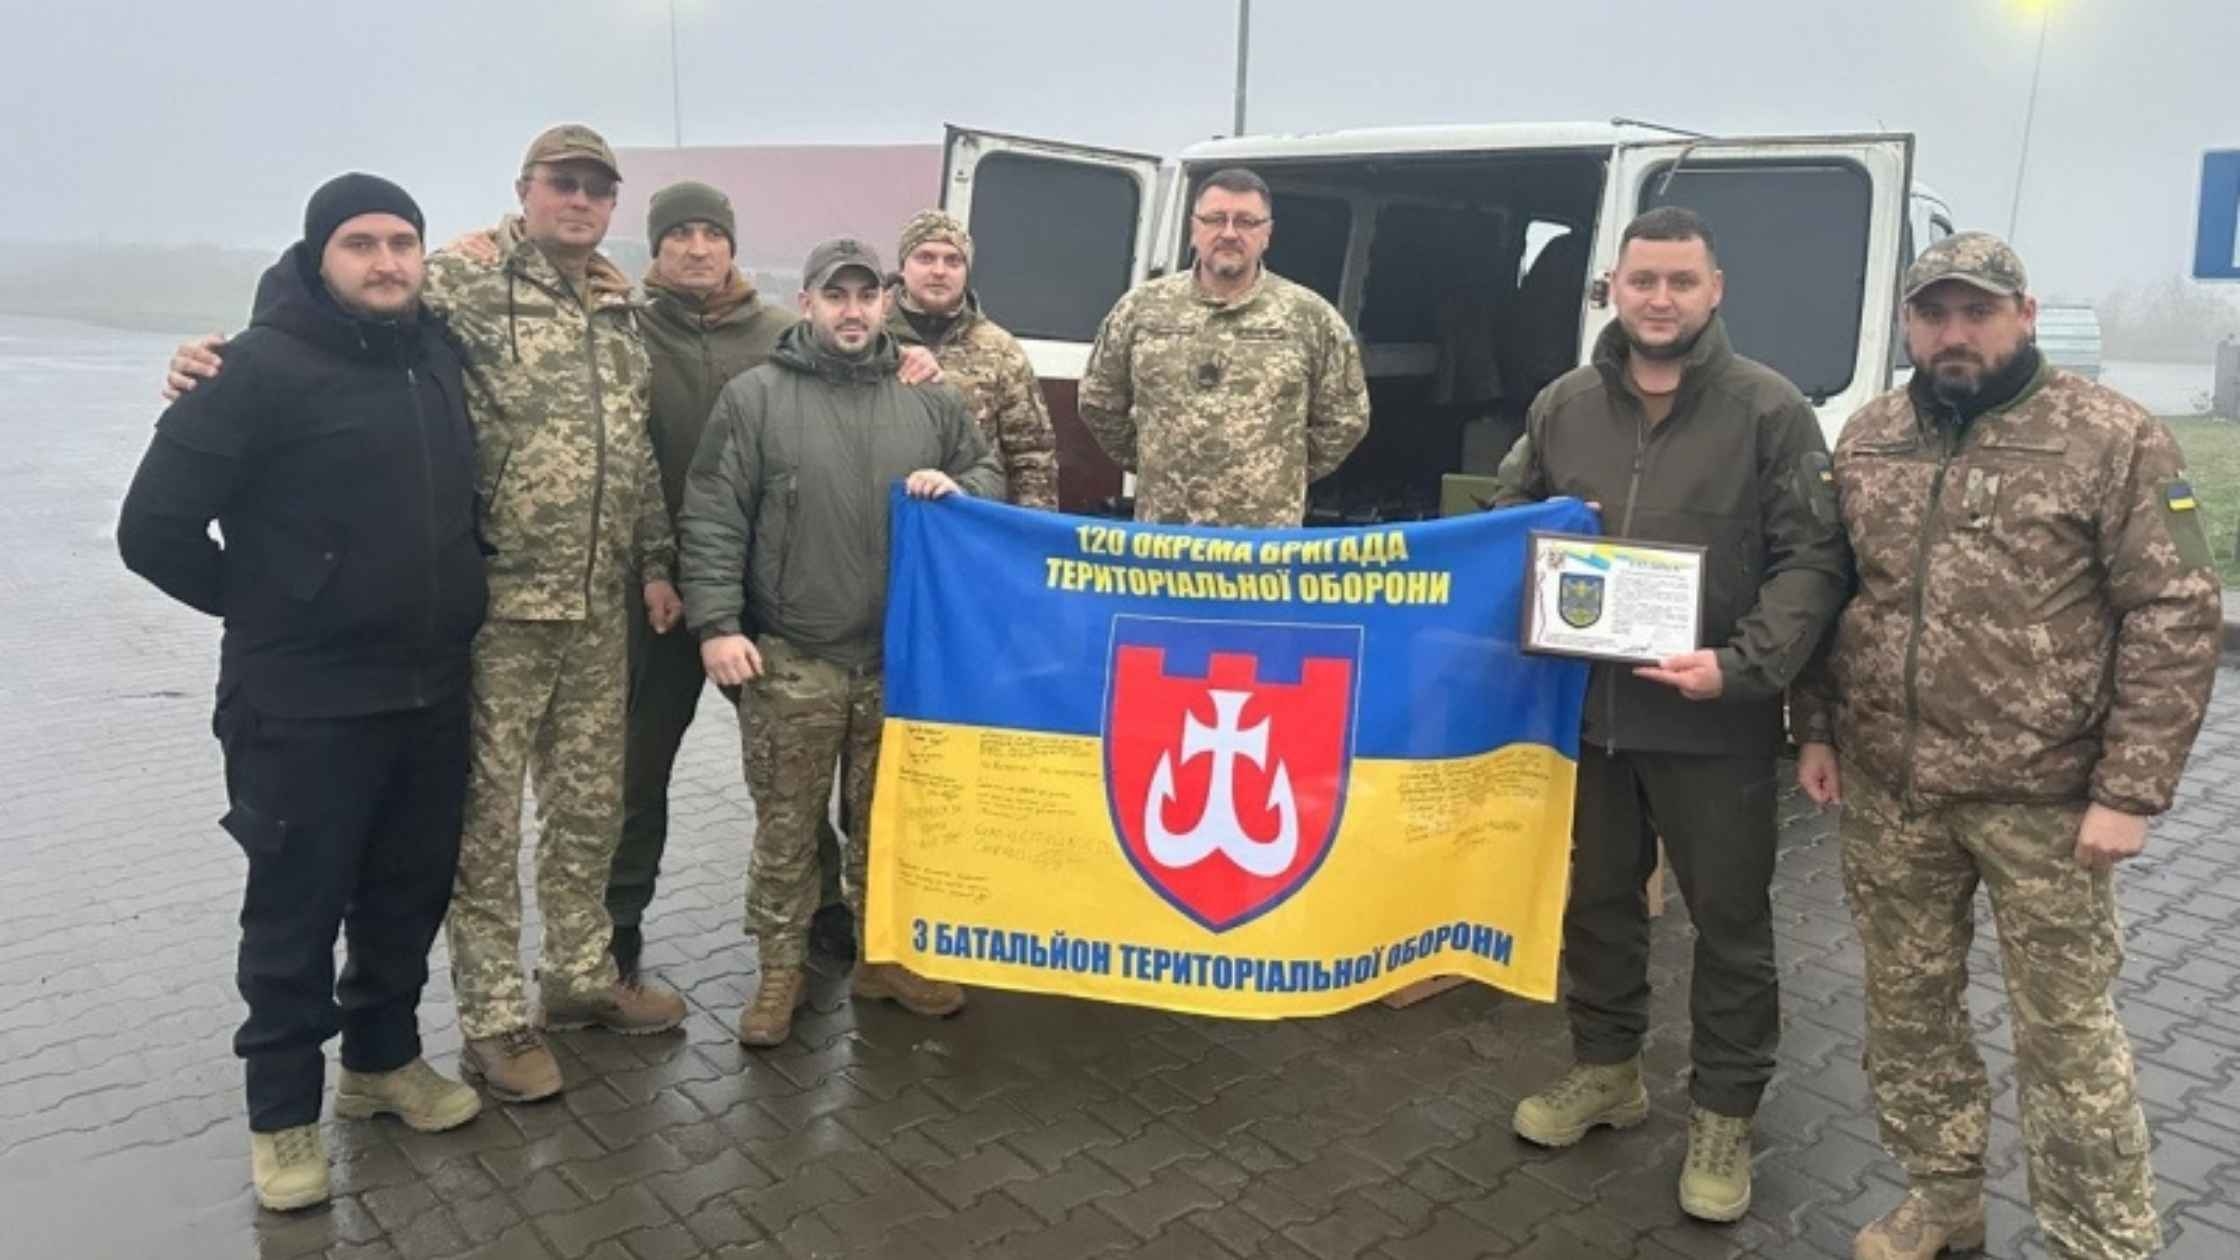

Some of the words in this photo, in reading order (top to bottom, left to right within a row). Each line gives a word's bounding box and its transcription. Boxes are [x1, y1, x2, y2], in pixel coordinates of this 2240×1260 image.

[1075, 525, 1126, 556] 120
[1132, 532, 1252, 564] ОКРЕМА
[1259, 530, 1409, 567] БРИГАДА
[1045, 557, 1292, 602] ТЕРИТОРІАЛЬНОЇ
[1299, 571, 1452, 605] ОБОРОНИ
[912, 918, 929, 953] 3
[934, 922, 1112, 976] БАТАЛЬЙОН
[1119, 944, 1385, 993] ТЕРИТОРІАЛЬНОЇ
[1385, 921, 1514, 972] ОБОРОНИ
